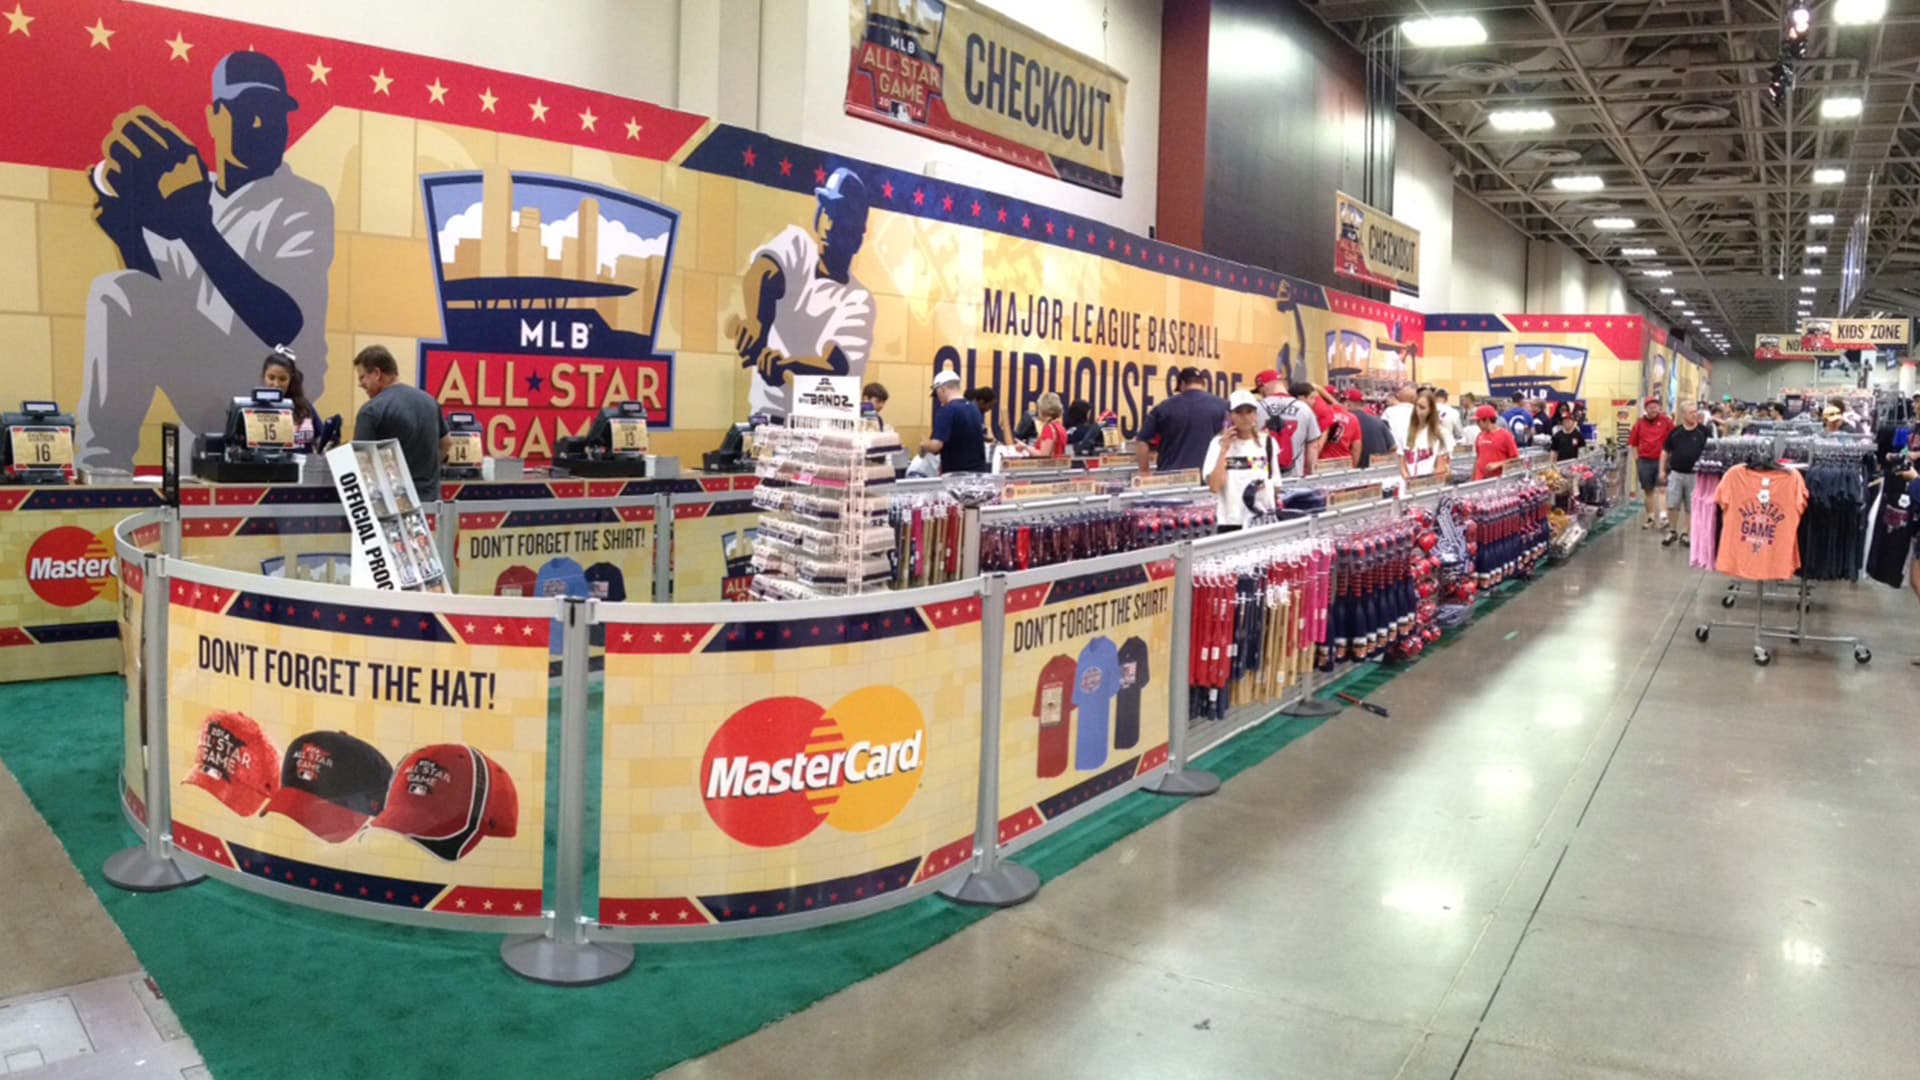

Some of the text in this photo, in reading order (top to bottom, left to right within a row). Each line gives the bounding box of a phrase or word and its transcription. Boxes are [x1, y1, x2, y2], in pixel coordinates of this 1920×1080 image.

[891, 35, 916, 54] MLB
[863, 46, 941, 89] ALL STAR
[879, 72, 924, 105] GAME
[964, 32, 1112, 151] CHECKOUT
[1369, 224, 1416, 273] CHECKOUT
[520, 318, 589, 349] MLB
[983, 287, 1221, 360] MAJOR LEAGUE BASEBALL
[1837, 324, 1901, 340] KIDS' ZONE
[437, 360, 662, 409] ALL STAR
[263, 424, 277, 441] 15
[35, 444, 51, 463] 16
[454, 447, 467, 462] 14
[339, 471, 377, 546] OFFICIAL
[470, 527, 645, 559] DON'T FORGET THE SHIRT!
[1741, 520, 1776, 539] GAME
[1013, 586, 1168, 653] DON'T FORGET THE SHIRT!
[198, 634, 496, 710] DON'T FORGET THE HAT!
[217, 738, 251, 769] STAR
[704, 730, 923, 800] MasterCard
